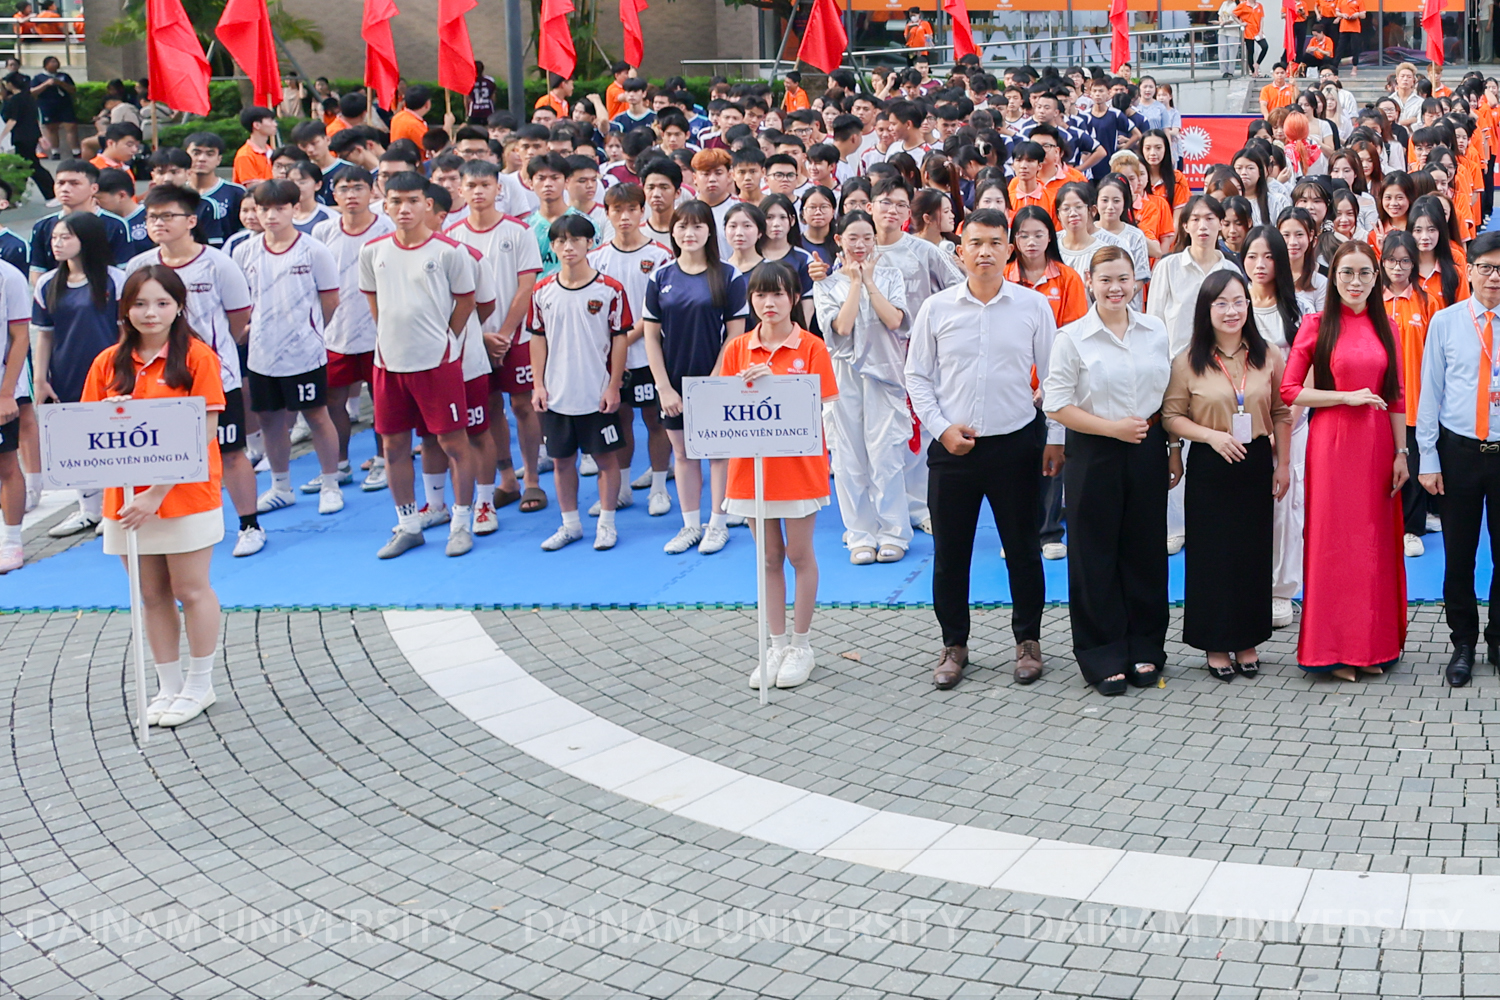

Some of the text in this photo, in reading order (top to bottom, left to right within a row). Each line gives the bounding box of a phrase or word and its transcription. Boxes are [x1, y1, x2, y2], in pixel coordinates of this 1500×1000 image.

[297, 382, 316, 402] 13
[634, 383, 655, 403] 99
[449, 402, 459, 422] 1
[723, 396, 782, 422] KHỐI
[87, 421, 160, 450] KHỐI
[217, 423, 237, 445] 10
[600, 424, 619, 445] 10
[697, 427, 809, 440] VẬN ĐỘNG VIÊN DANCE
[59, 459, 82, 470] VẬN
[83, 457, 114, 468] ĐỘNG
[115, 455, 141, 465] VIÊN
[175, 452, 190, 462] ĐÁ
